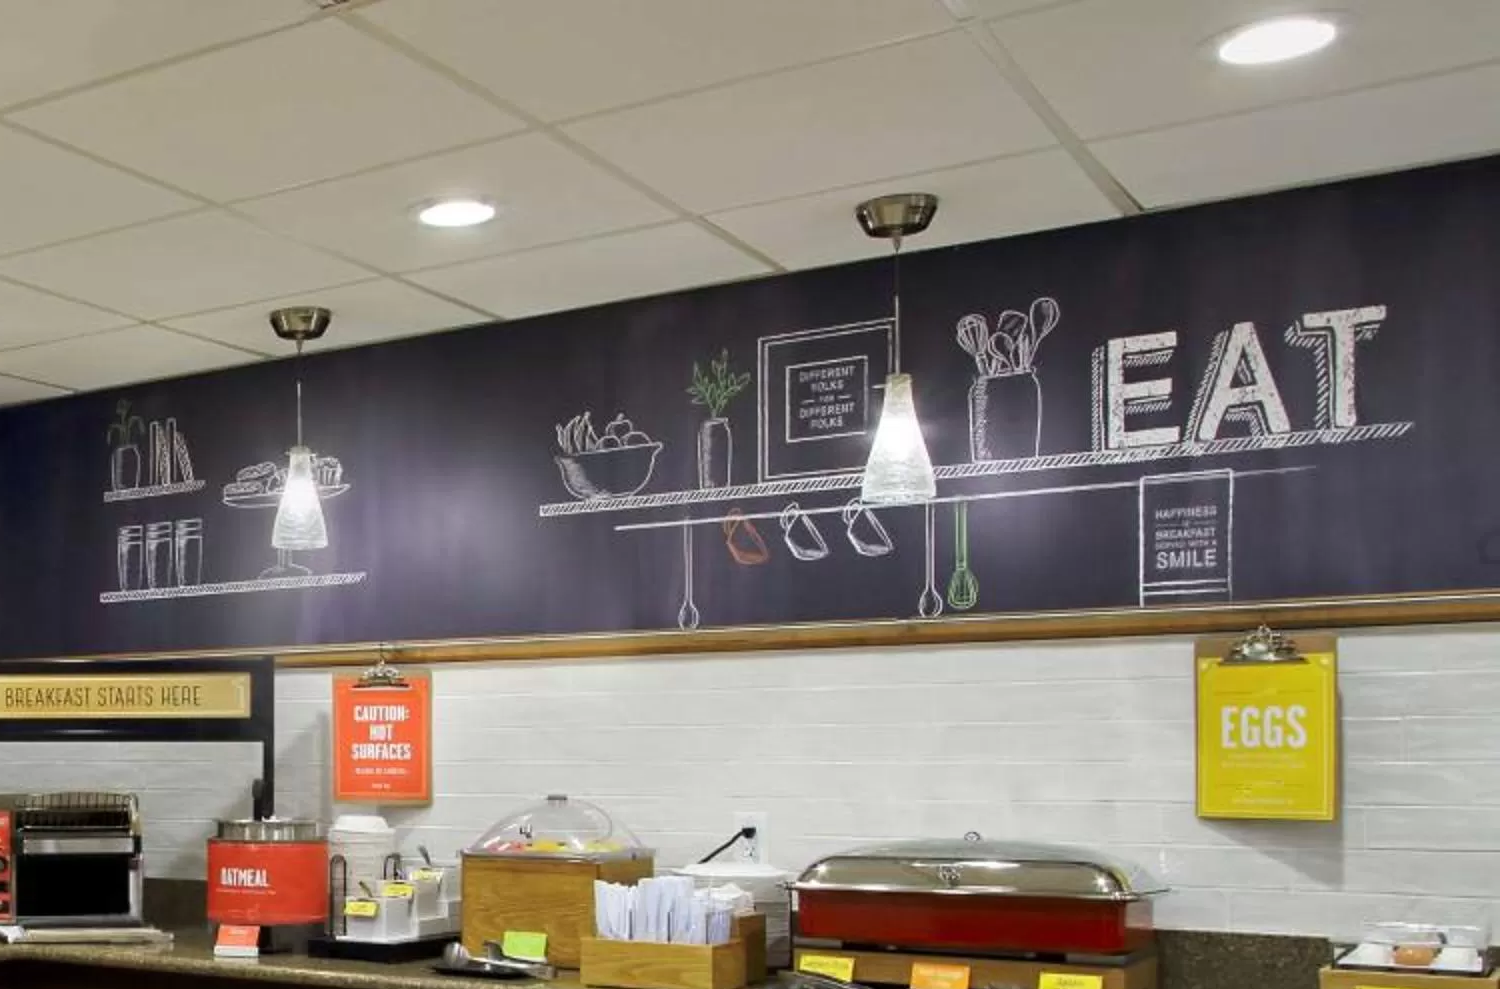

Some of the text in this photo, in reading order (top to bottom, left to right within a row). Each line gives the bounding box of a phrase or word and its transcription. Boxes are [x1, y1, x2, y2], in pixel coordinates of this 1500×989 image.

[799, 365, 856, 383] DIFFERENT
[1091, 304, 1388, 452] EAT
[799, 402, 856, 420] DIFFERENT
[1156, 548, 1218, 569] SMILE
[4, 686, 93, 708] BREAKFAST
[97, 685, 155, 708] STARTS
[160, 684, 204, 707] HERE
[353, 704, 411, 722] CAUTION:
[369, 723, 394, 740] HOT
[1220, 704, 1308, 749] EGGS
[351, 743, 411, 760] SURFACES
[220, 867, 270, 887] OATMEAL
